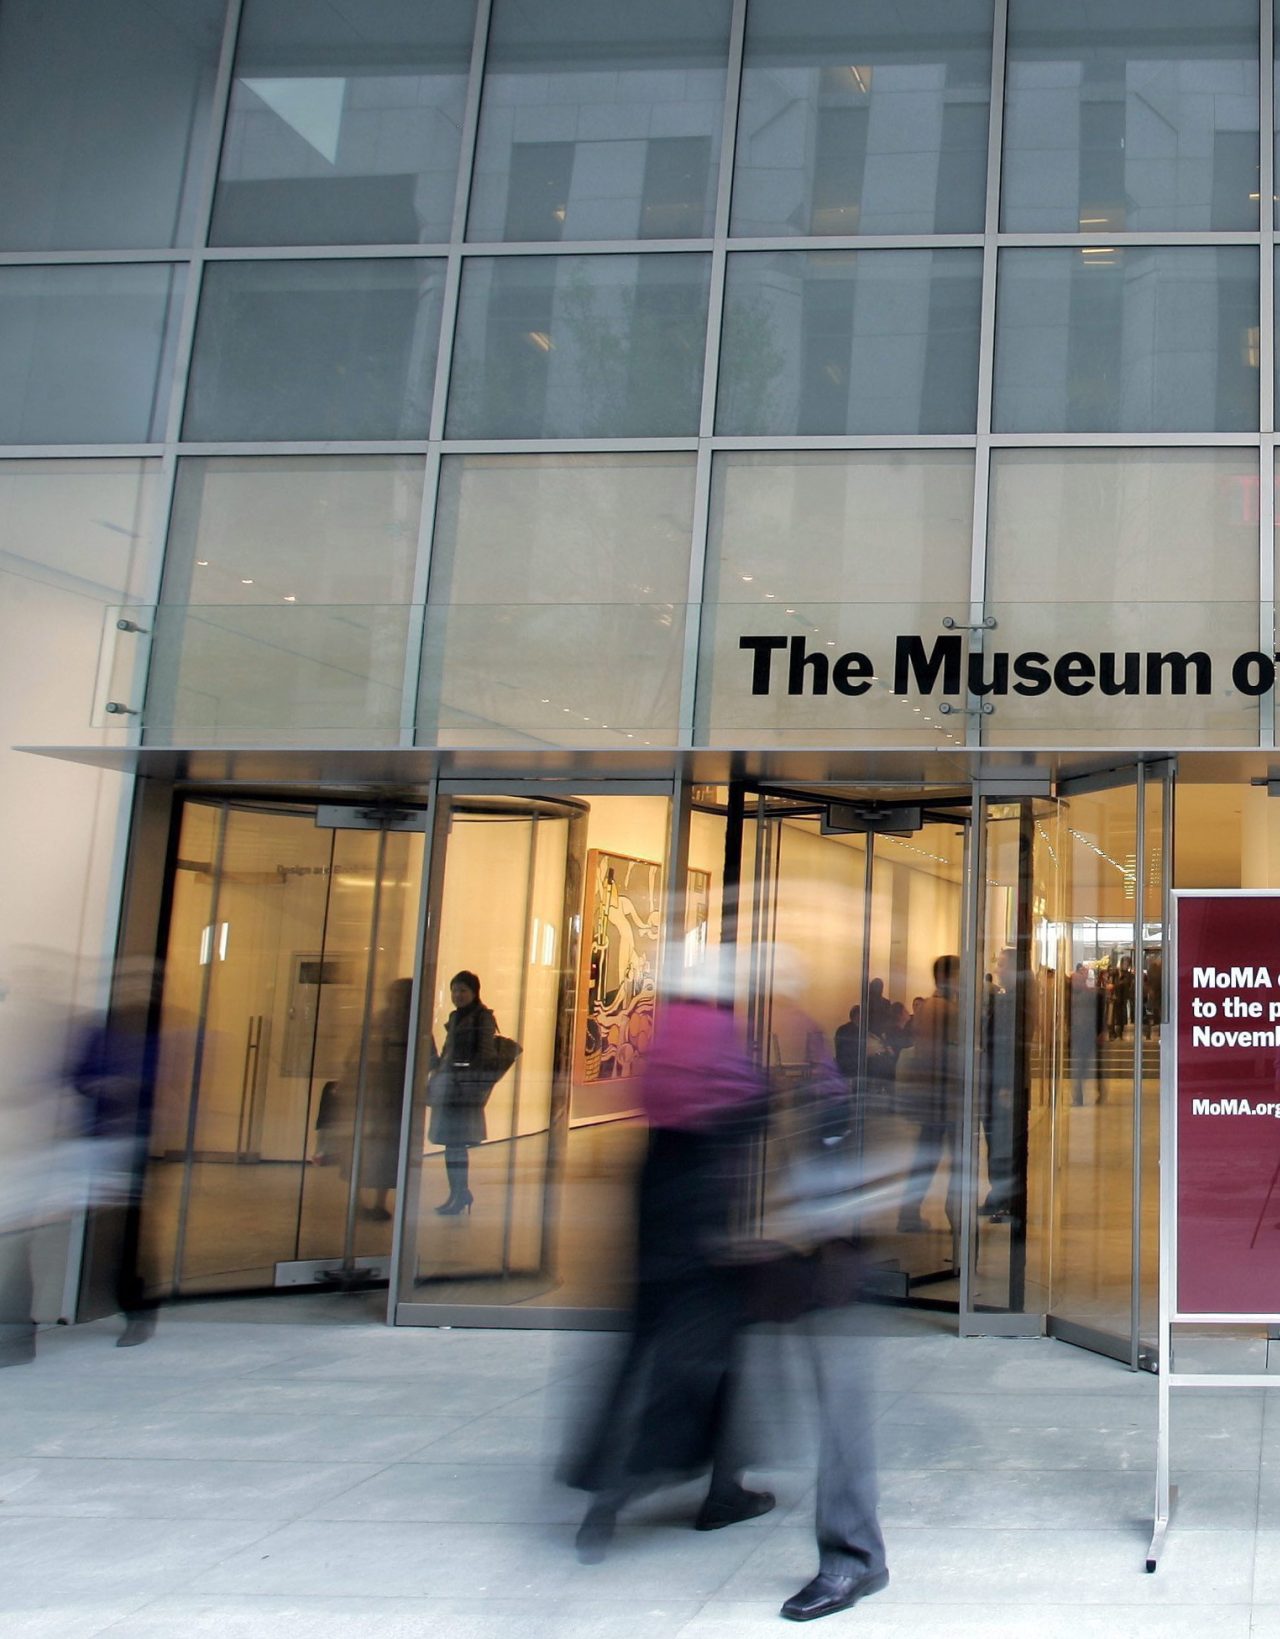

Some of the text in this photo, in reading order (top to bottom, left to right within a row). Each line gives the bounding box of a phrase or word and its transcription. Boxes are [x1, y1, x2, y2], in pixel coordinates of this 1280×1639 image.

[739, 635, 874, 696] The
[894, 635, 1212, 697] Museum
[1192, 967, 1273, 989] MoMA
[1192, 998, 1217, 1018] to
[1222, 996, 1263, 1018] the
